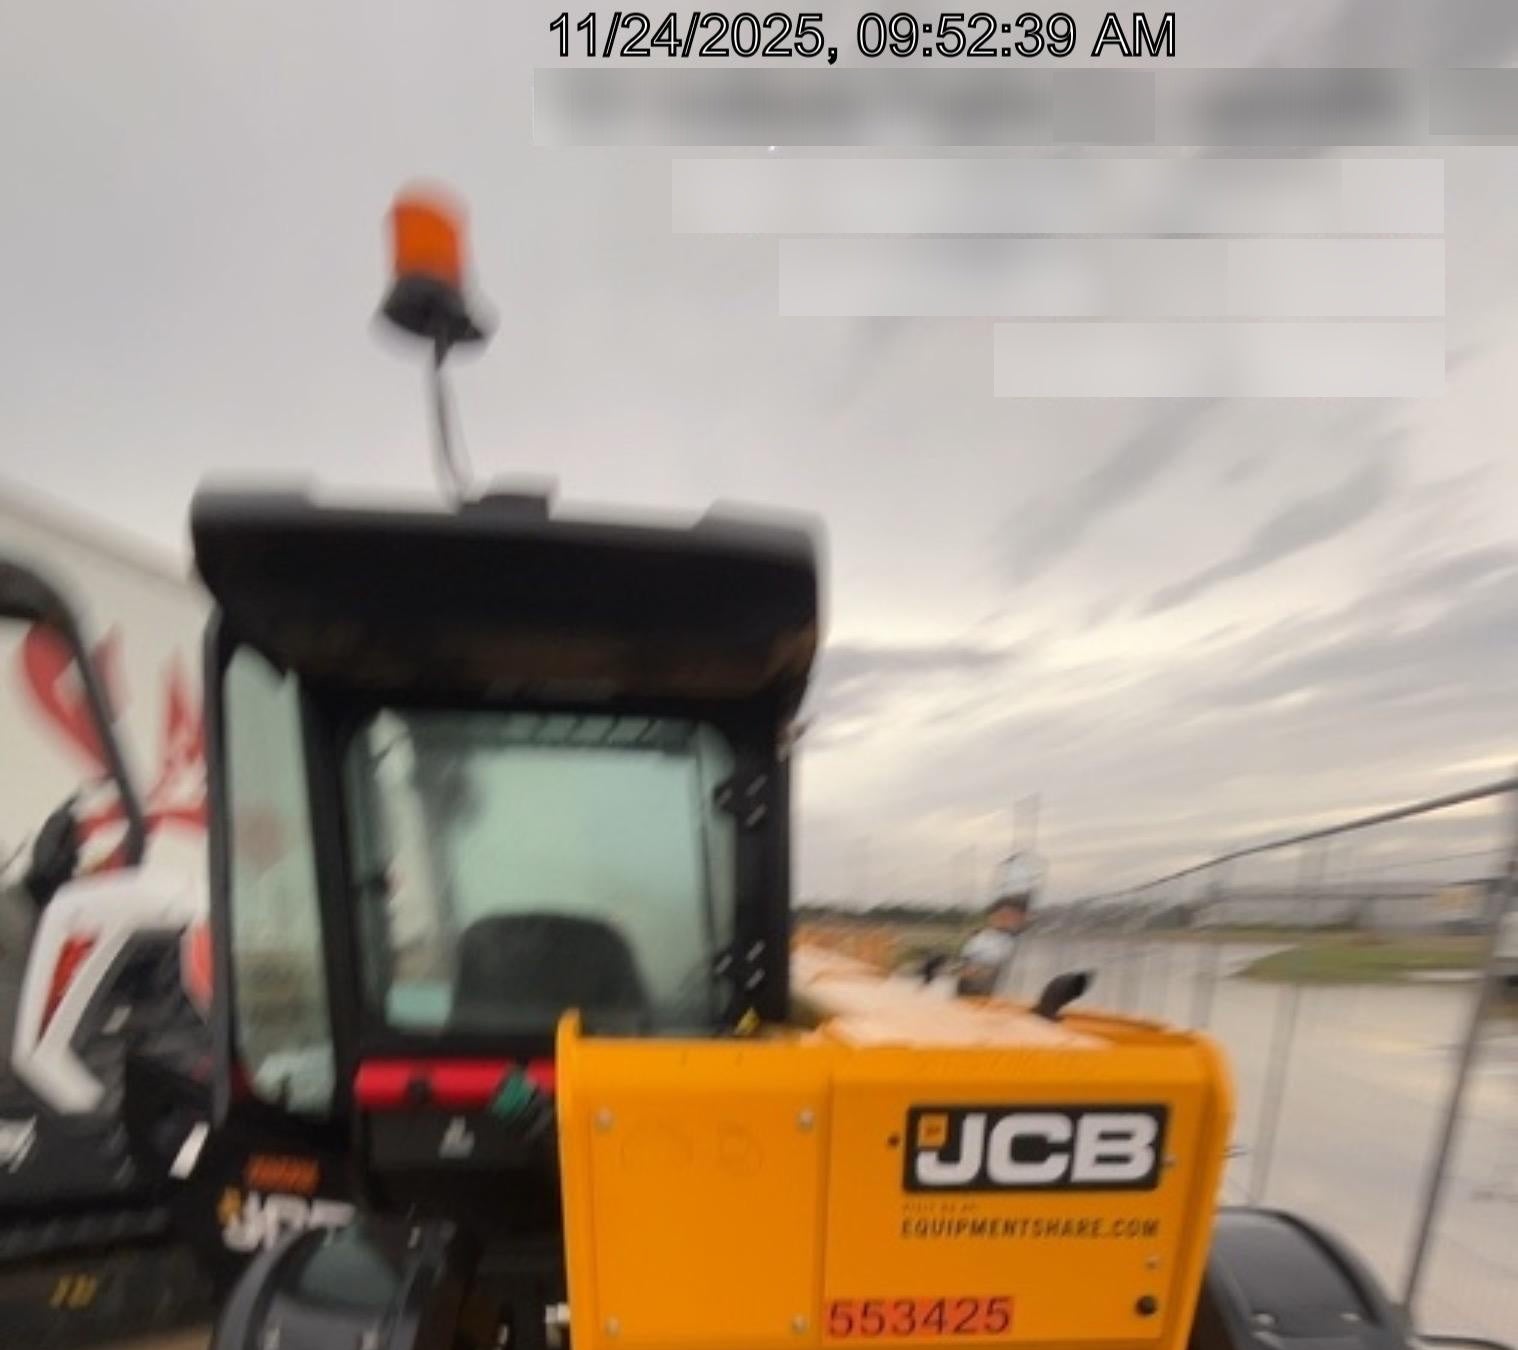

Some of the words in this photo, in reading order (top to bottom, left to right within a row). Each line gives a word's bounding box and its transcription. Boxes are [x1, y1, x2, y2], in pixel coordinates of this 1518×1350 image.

[914, 1112, 1159, 1186] JCB
[902, 1218, 1160, 1238] EQUIPMENTSHARE.COM
[830, 1297, 1012, 1337] 553425
